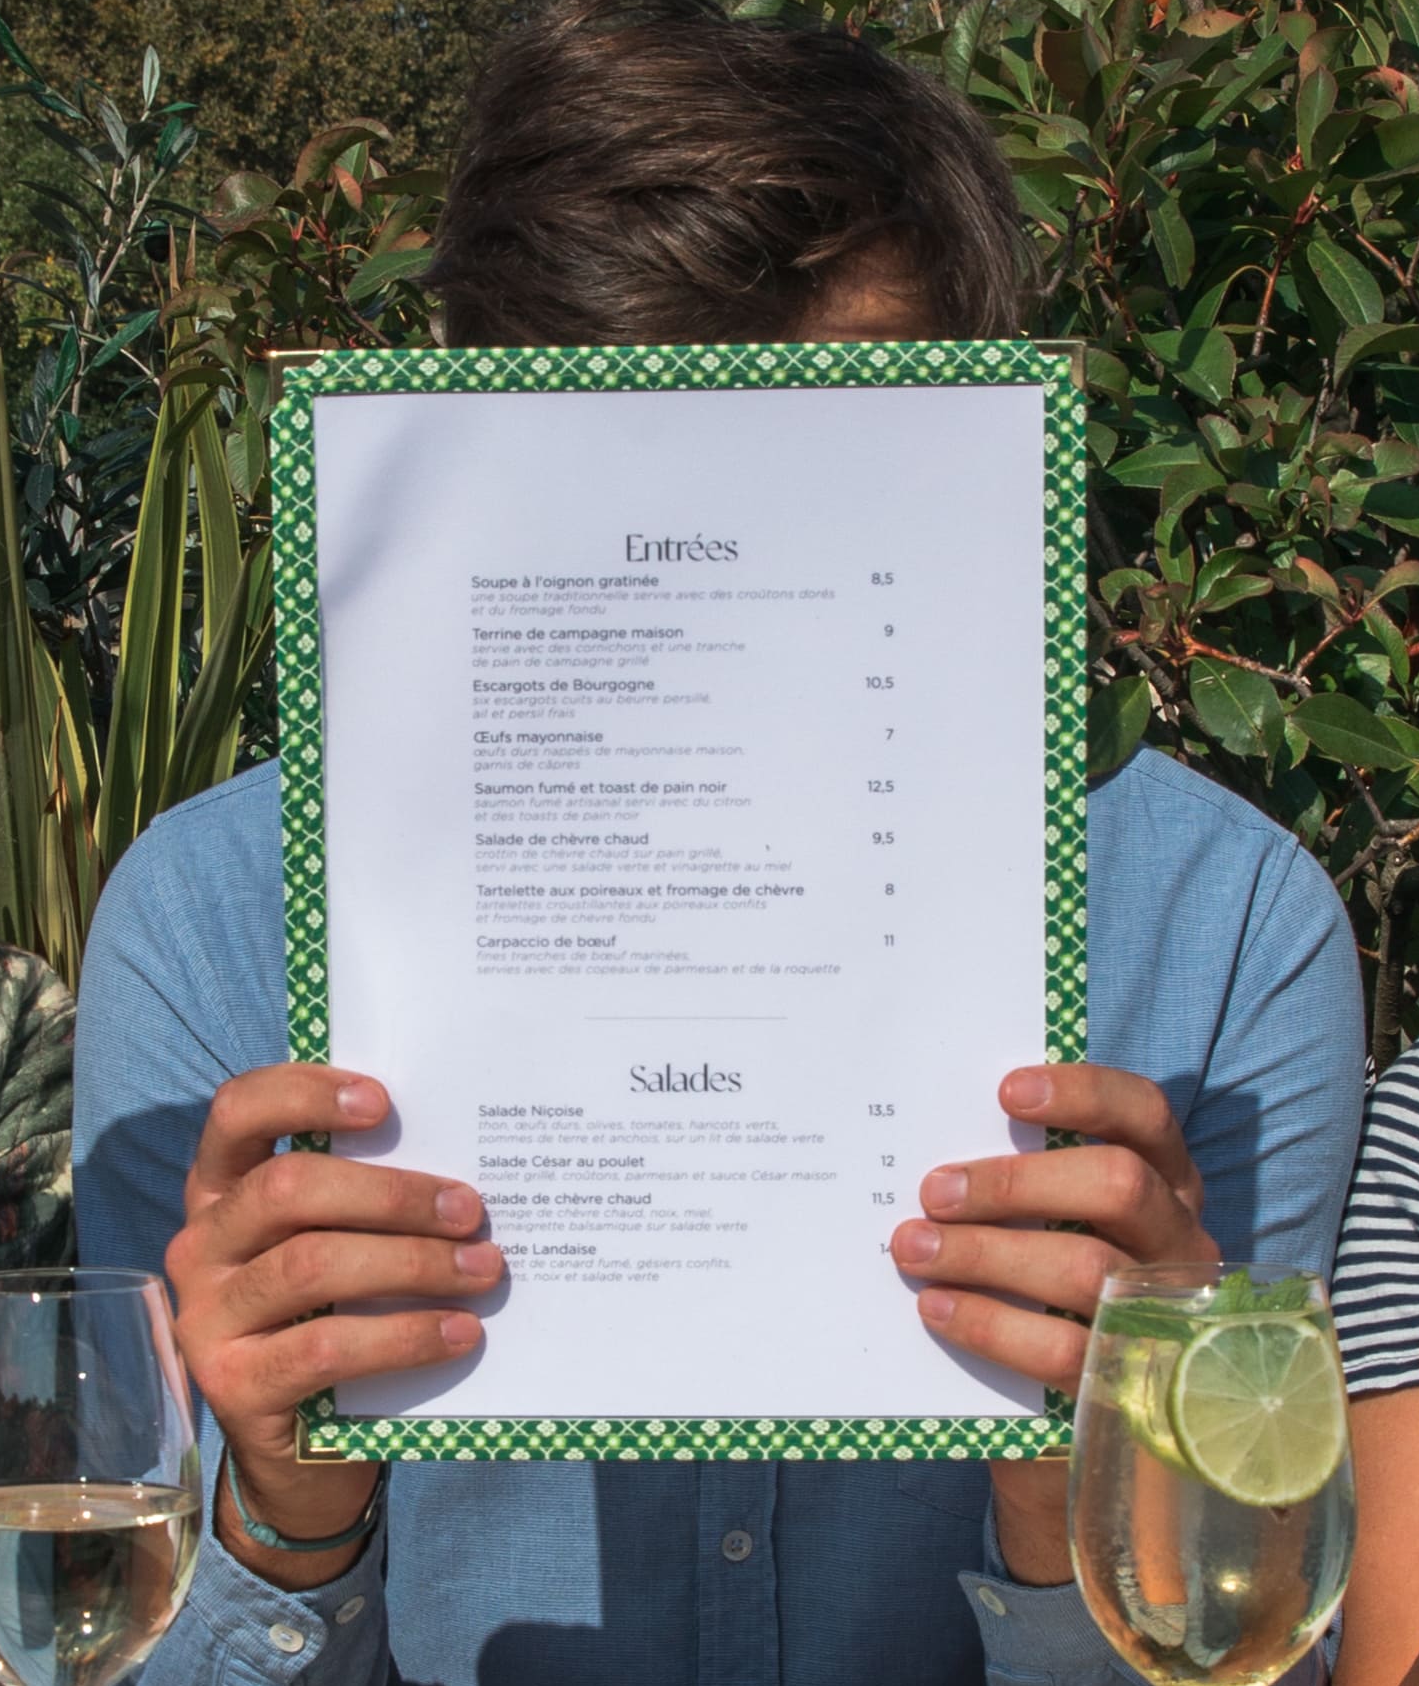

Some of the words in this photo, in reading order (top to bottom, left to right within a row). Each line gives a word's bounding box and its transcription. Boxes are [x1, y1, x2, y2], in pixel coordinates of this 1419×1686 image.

[625, 532, 739, 563] Entrées
[471, 575, 518, 590] Soupe
[522, 575, 531, 588] à
[598, 574, 660, 590] gratinée
[870, 572, 895, 586] 8,5
[472, 627, 523, 641] Terrine
[526, 627, 545, 640] de
[549, 629, 627, 642] campagne
[631, 627, 684, 639] maison
[883, 624, 895, 638] 9
[471, 657, 489, 668] de
[492, 658, 521, 669] pain
[524, 657, 542, 668] de
[544, 658, 613, 668] campagne
[617, 655, 650, 668] grillé
[475, 833, 524, 846] Salade
[528, 834, 547, 845] de
[551, 833, 600, 845] chèvre
[604, 832, 649, 845] chaud
[871, 831, 895, 845] 9,5
[476, 884, 545, 897] Tartelette
[549, 886, 575, 897] aux
[580, 886, 643, 898] poireaux
[647, 885, 662, 896] et
[666, 883, 728, 898] fromage
[732, 883, 751, 896] de
[755, 884, 805, 897] chèvre
[884, 883, 895, 896] 8
[476, 935, 550, 949] Carpaccio
[554, 935, 573, 947] de
[577, 934, 617, 947] bœuf
[883, 934, 895, 947] 11
[630, 1062, 742, 1093] Salades
[478, 1105, 527, 1117] Salade
[531, 1105, 584, 1118] Niçoise
[868, 1104, 895, 1118] 13,5
[479, 1155, 528, 1168] Salade
[531, 1155, 572, 1168] César
[576, 1158, 594, 1168] au
[598, 1155, 645, 1169] poulet
[880, 1154, 895, 1168] 12
[478, 1171, 520, 1181] poulet
[624, 1171, 689, 1181] parmesan
[691, 1170, 706, 1181] et
[709, 1171, 747, 1181] sauce
[750, 1169, 789, 1182] César
[790, 1171, 837, 1181] maison
